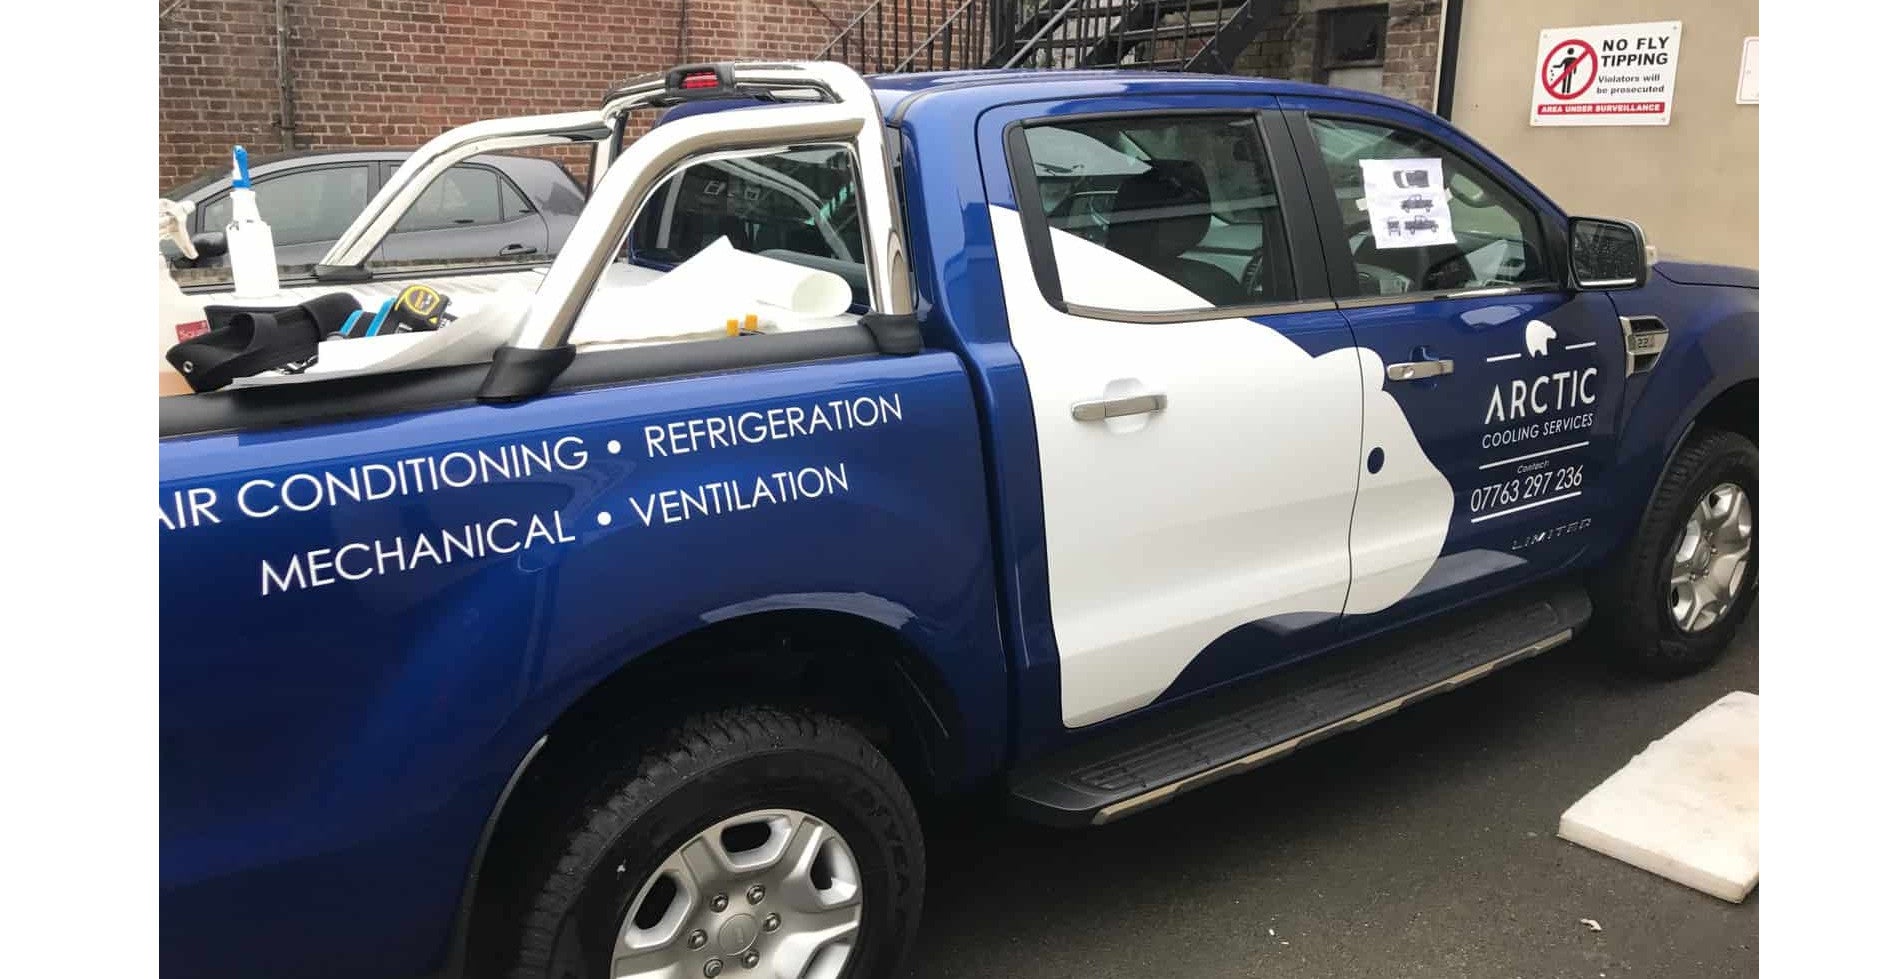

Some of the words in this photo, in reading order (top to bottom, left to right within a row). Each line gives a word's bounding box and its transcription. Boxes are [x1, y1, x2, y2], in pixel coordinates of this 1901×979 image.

[1602, 39, 1628, 52] NO
[1636, 36, 1670, 50] FLY
[1601, 52, 1668, 67] TIPPING
[1596, 85, 1608, 95] be
[1610, 84, 1665, 96] prosecuted
[1598, 75, 1640, 84] Violators
[1643, 74, 1661, 82] will
[1565, 105, 1593, 113] UNDER
[1595, 103, 1661, 112] SURVEILLANCE
[1484, 367, 1598, 425] ARCTIC
[1482, 423, 1539, 448] COOLING
[1543, 412, 1593, 436] SERVICES
[237, 436, 589, 518] CONDITIONING
[644, 392, 903, 458] REFRIGERATION
[1470, 479, 1520, 513] 07763
[1523, 471, 1553, 500] 297
[1555, 464, 1584, 491] 236
[261, 510, 576, 596] MECHANICAL
[629, 462, 849, 527] VENTILATION
